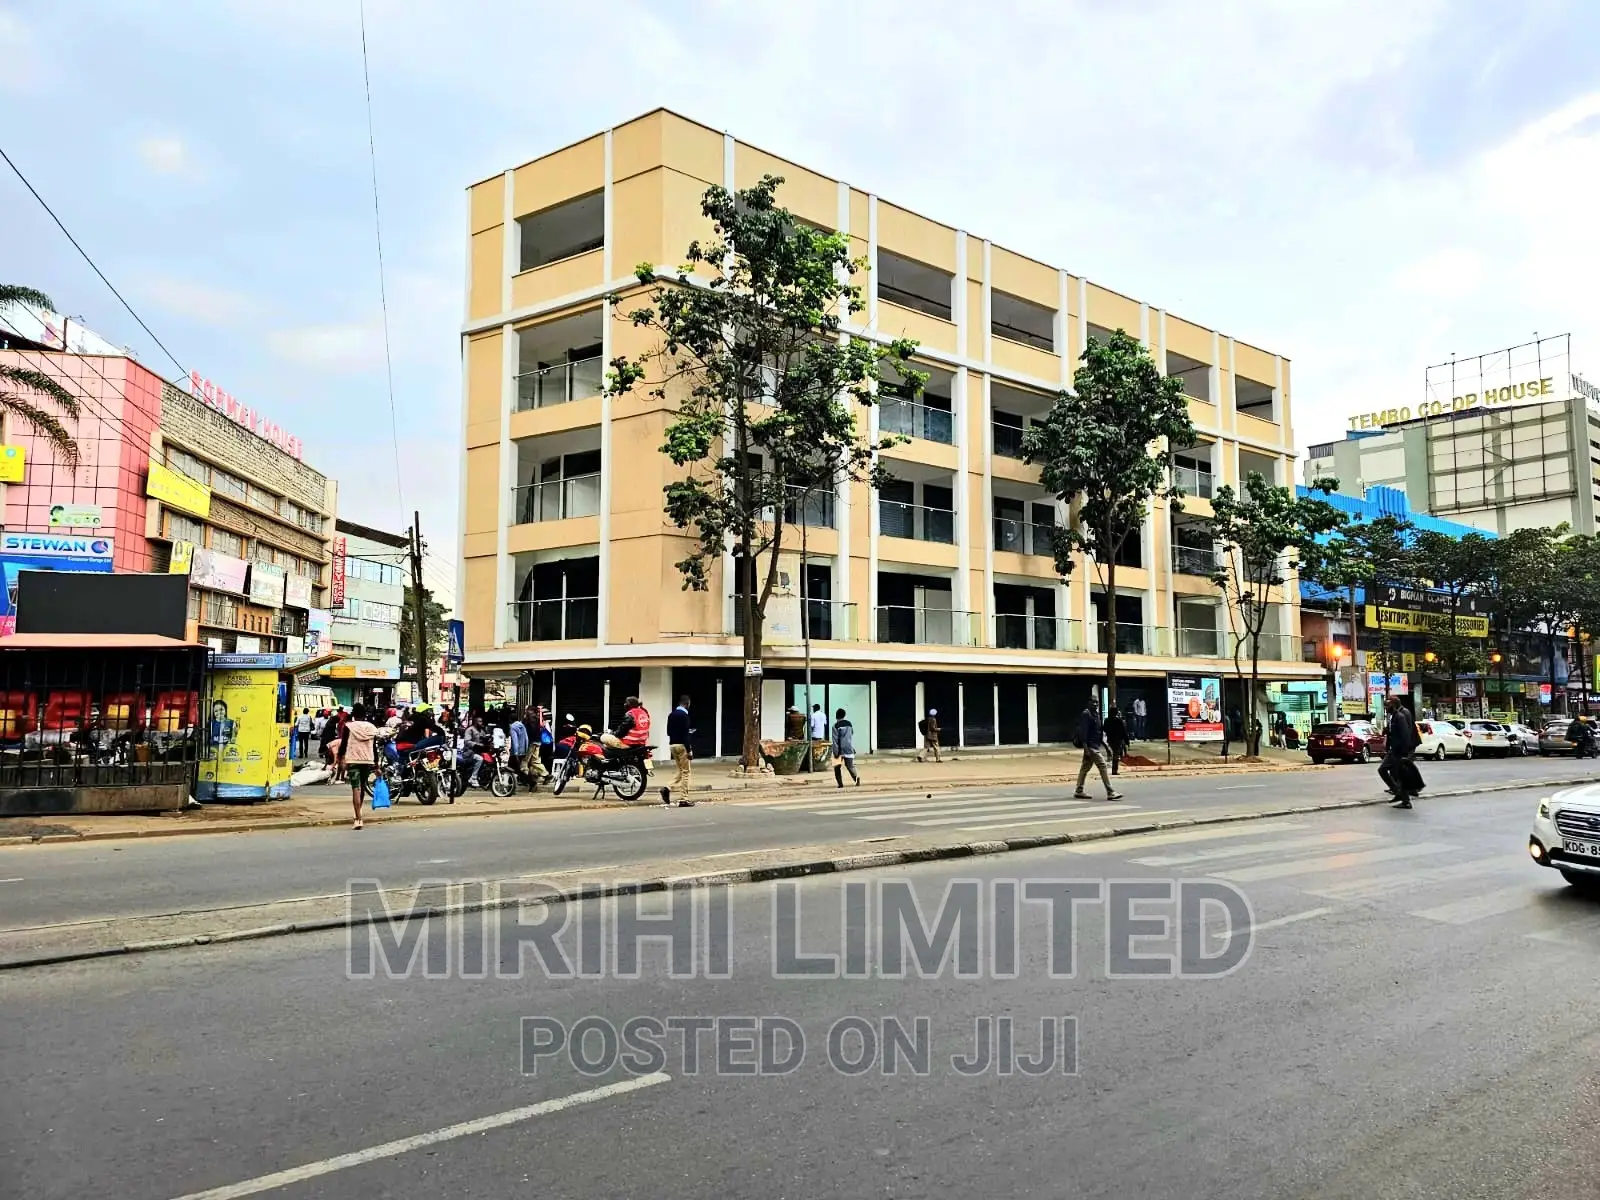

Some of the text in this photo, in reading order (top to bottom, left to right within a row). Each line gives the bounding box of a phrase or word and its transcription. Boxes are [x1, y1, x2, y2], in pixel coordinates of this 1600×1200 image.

[1348, 405, 1411, 430] TEMBO
[1418, 392, 1478, 418] CO-OP
[1484, 376, 1555, 406] HOUSE
[6, 537, 86, 553] STEWAN
[1565, 841, 1586, 854] KDG
